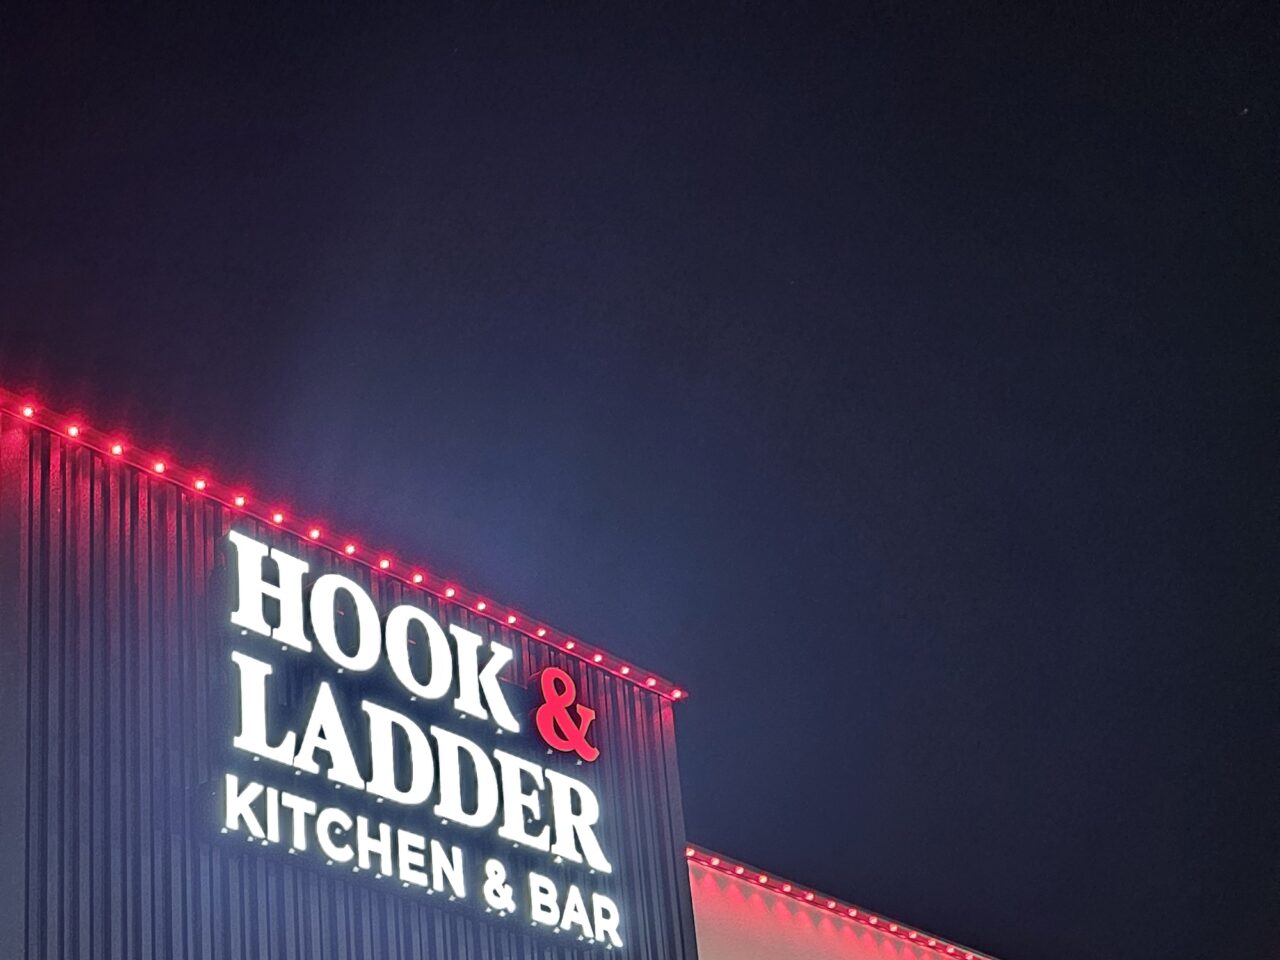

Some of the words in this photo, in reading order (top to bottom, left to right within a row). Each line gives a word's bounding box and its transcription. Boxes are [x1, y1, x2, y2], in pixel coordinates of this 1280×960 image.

[229, 530, 520, 733] HOOK
[535, 667, 600, 762] &
[225, 773, 466, 899] KITCHEN
[483, 858, 516, 914] &
[529, 871, 624, 948] BAR
[231, 651, 612, 874] LADDER
